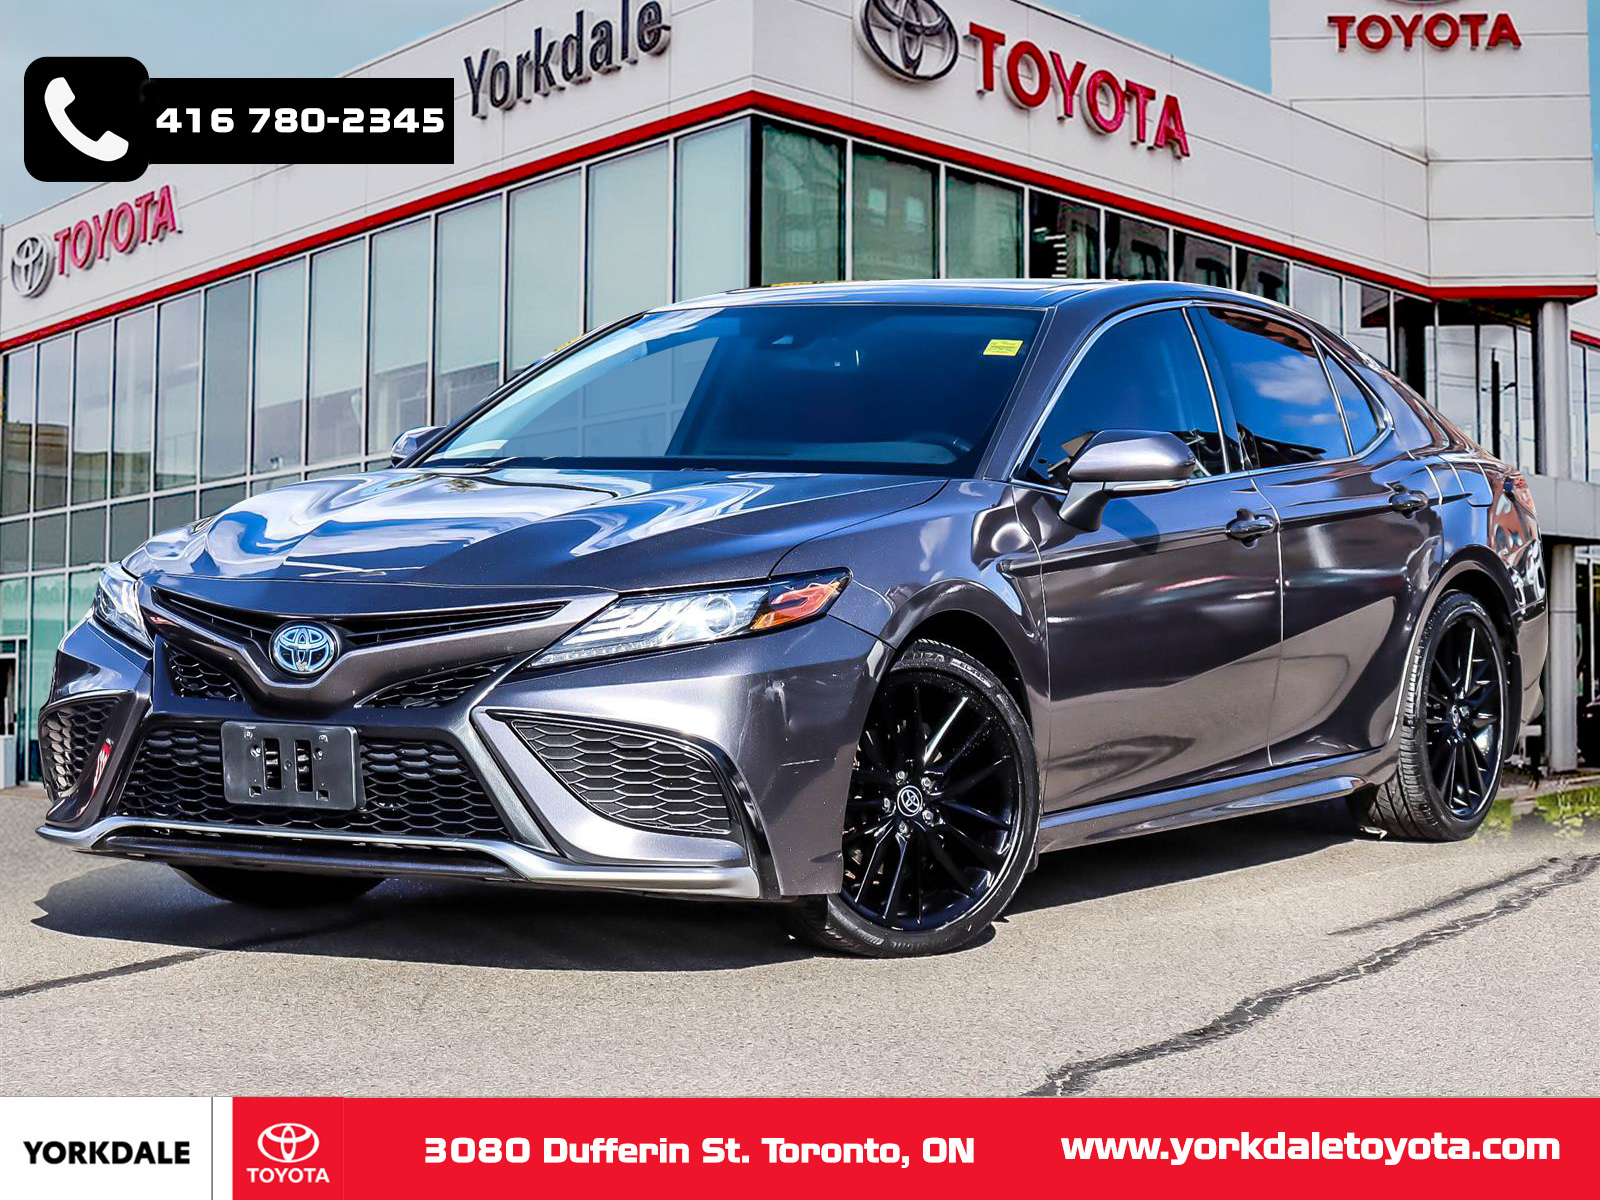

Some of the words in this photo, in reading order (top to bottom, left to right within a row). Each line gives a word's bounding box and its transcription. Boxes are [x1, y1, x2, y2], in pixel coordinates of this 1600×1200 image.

[463, 0, 671, 117] Yorkdale
[1327, 13, 1523, 50] TOYOTA
[966, 22, 1190, 158] TOYOTA
[54, 184, 181, 276] TOYOTA
